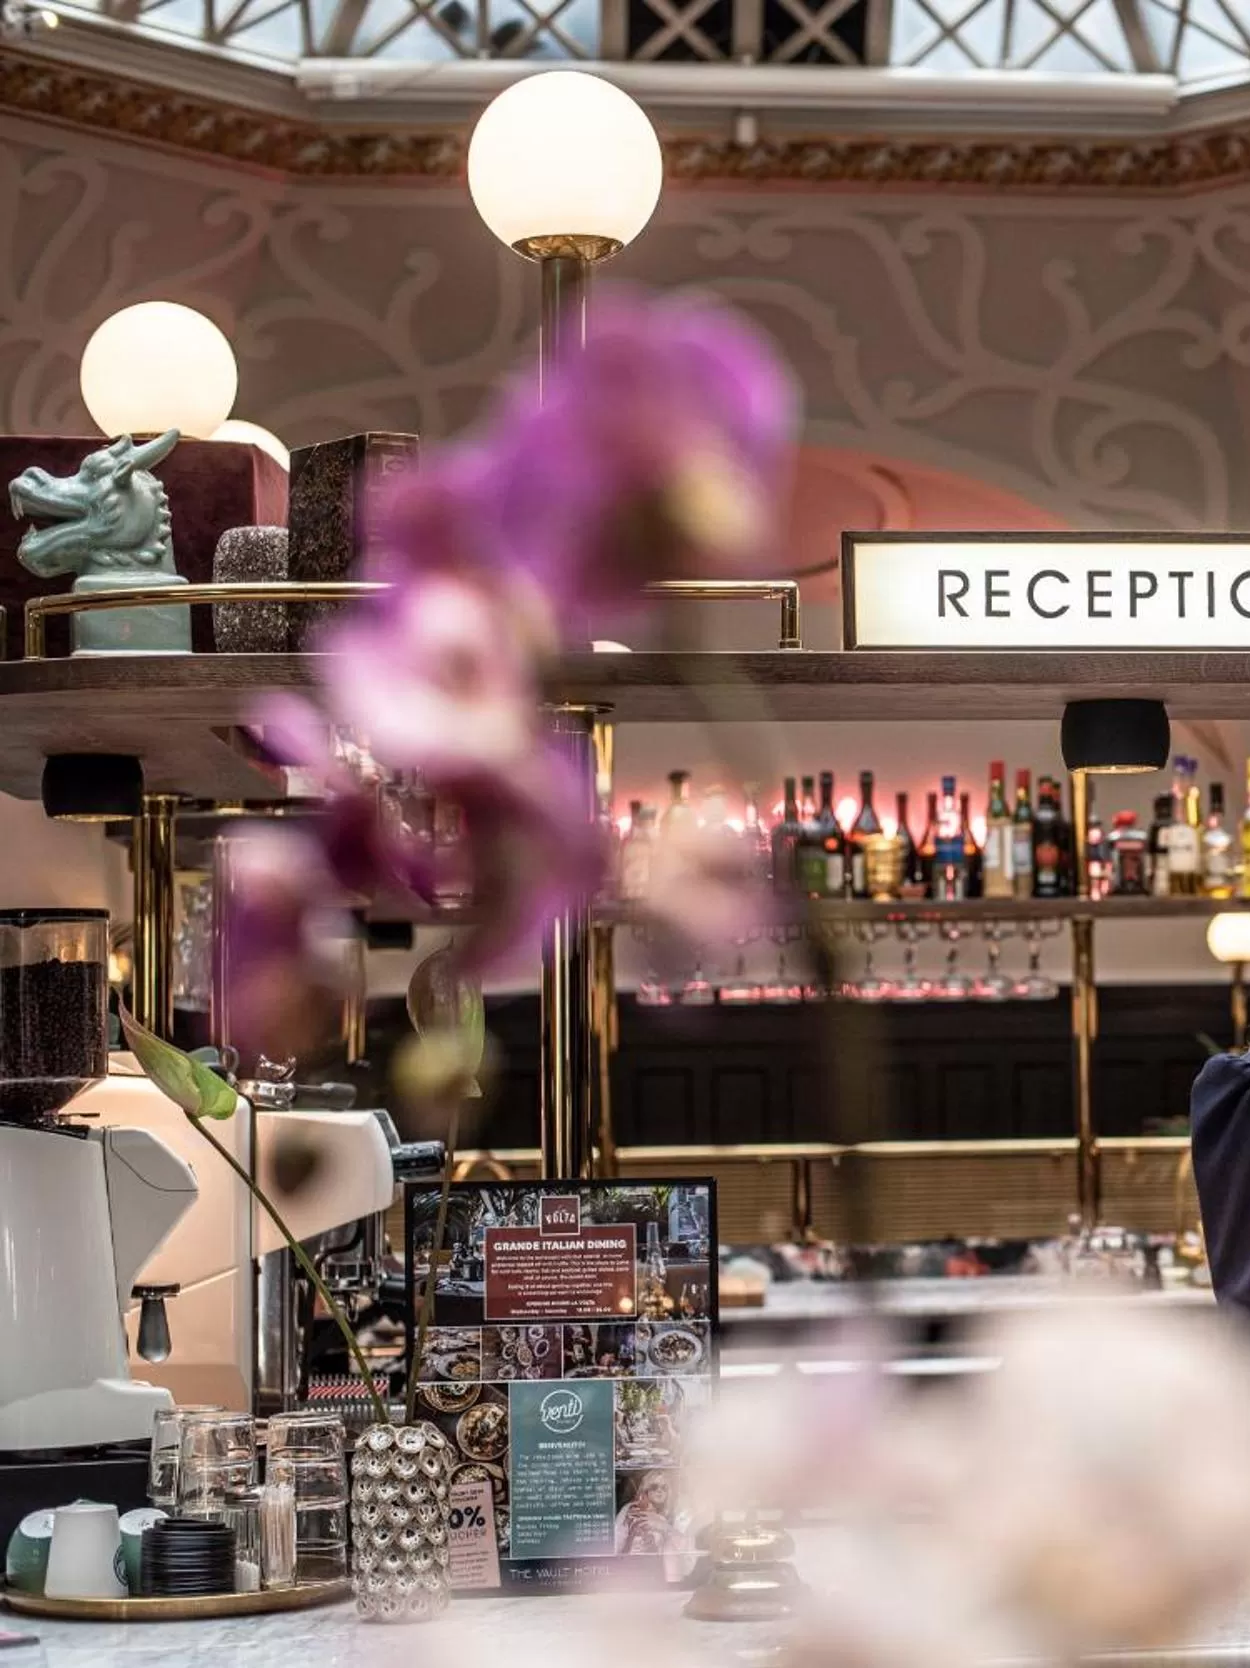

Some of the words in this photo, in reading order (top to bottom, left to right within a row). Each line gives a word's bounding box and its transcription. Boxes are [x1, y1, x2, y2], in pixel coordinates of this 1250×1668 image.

[493, 1241, 540, 1251] GRANDE
[542, 1240, 585, 1250] ITALIAN
[587, 1239, 627, 1249] DINING
[448, 1505, 486, 1530] 0%
[509, 1568, 533, 1580] THE
